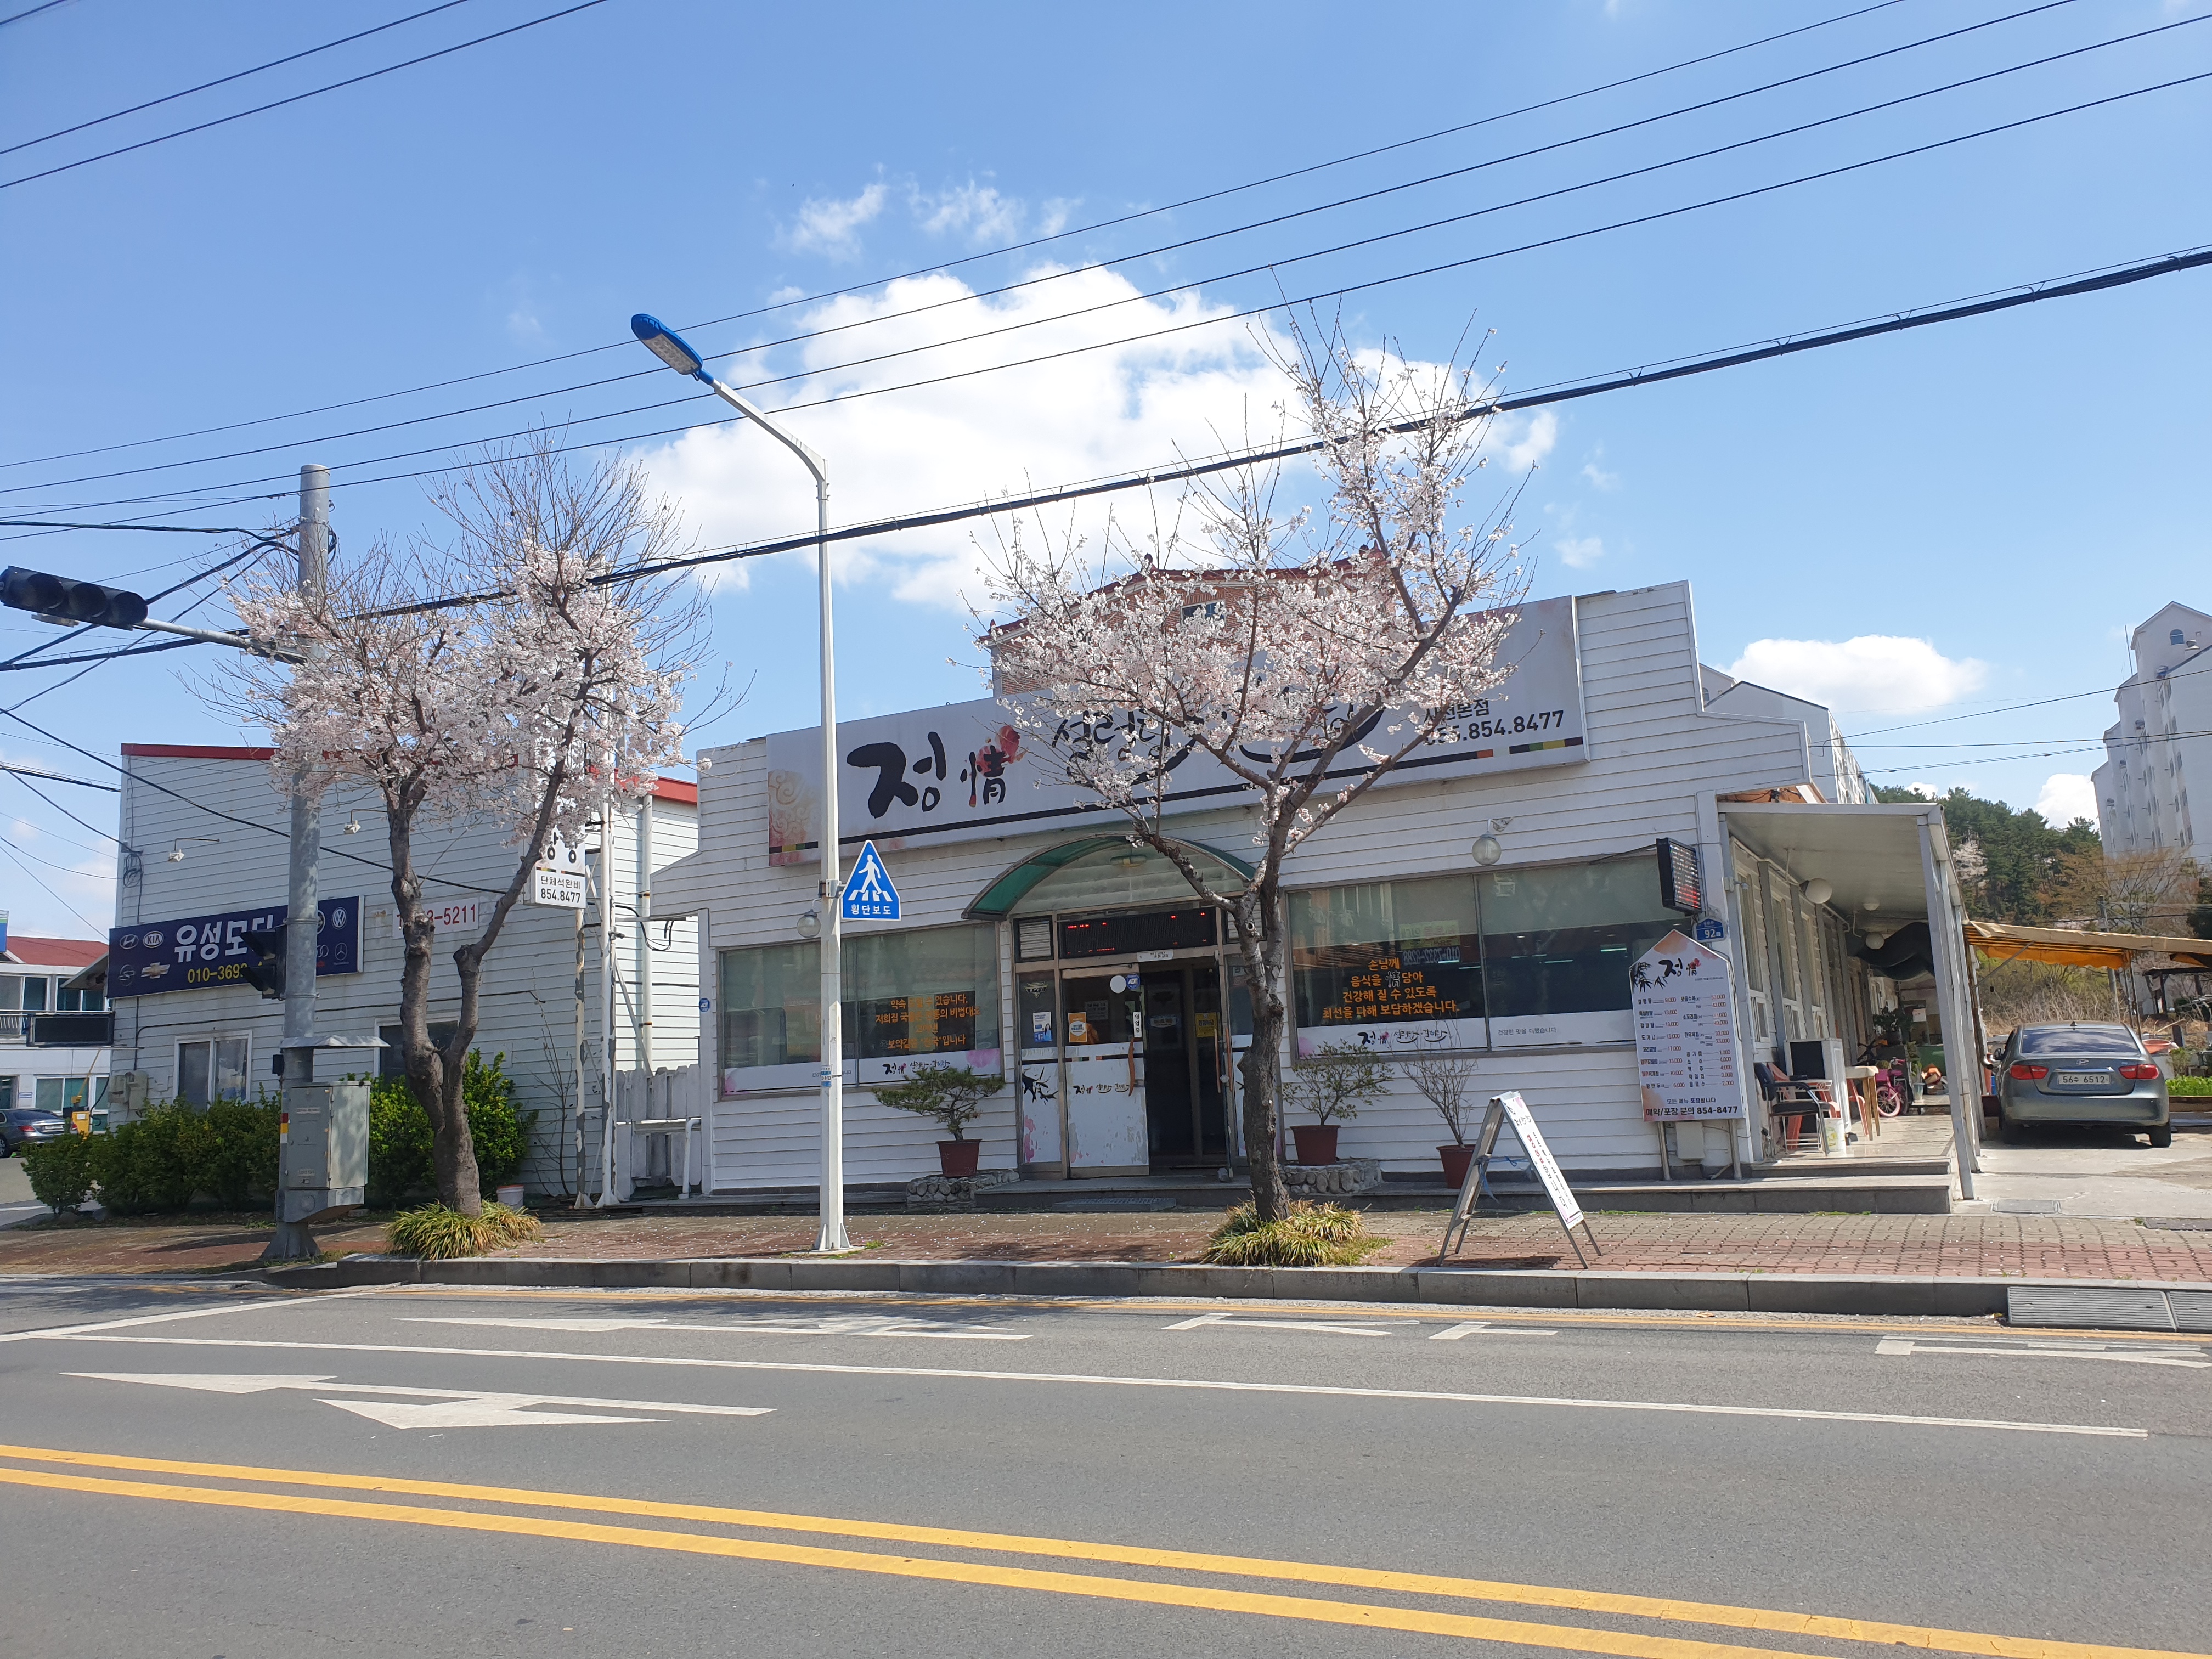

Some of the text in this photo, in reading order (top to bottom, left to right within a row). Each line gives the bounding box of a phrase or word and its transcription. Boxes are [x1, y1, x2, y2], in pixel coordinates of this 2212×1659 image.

[541, 876, 581, 890] 단체석완비
[541, 888, 581, 904] 854.8477
[850, 904, 891, 915] 횡단보도
[1704, 929, 1716, 938] 92
[1368, 957, 1400, 972] 손님께
[1350, 974, 1382, 988] 음식을
[1402, 971, 1424, 984] 담아
[891, 998, 906, 1010] 약속
[935, 993, 968, 1007] 있습니다.
[1342, 985, 1437, 1004] 건강해 질 수 있도록
[1322, 999, 1460, 1020] 최선을 다해 보답하겠습니다.
[876, 1012, 898, 1024] 저희집
[1645, 1105, 1739, 1117] 예약/포장 문의 854-8477
